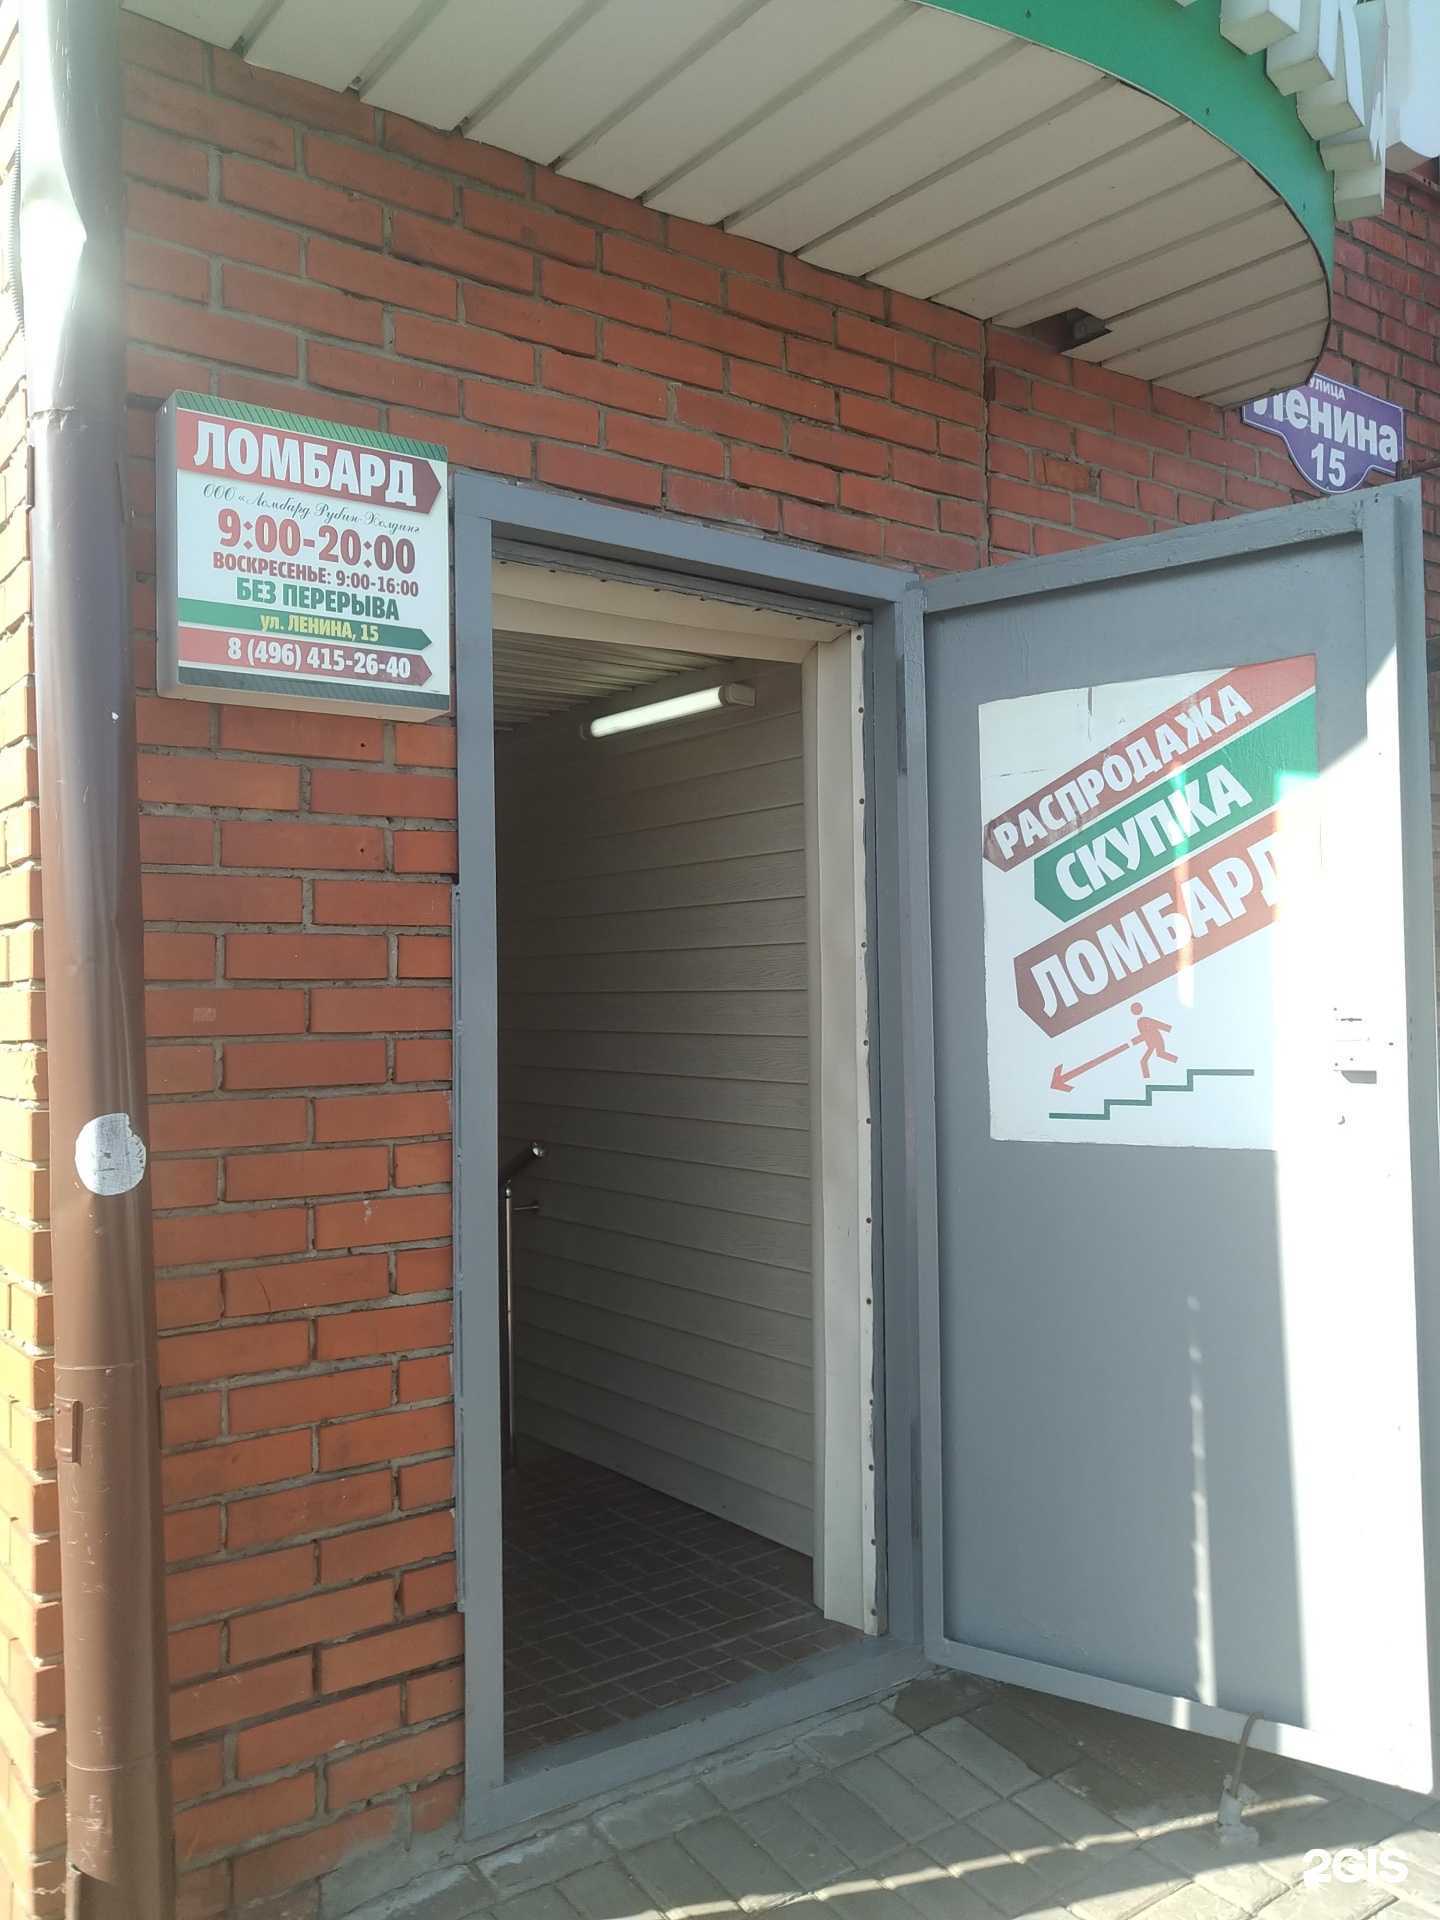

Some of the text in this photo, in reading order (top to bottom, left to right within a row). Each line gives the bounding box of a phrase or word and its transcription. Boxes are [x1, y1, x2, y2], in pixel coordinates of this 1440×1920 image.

[193, 420, 417, 507] ЛОМБАРД
[1311, 443, 1346, 487] 15
[203, 483, 237, 499] ООО
[218, 508, 415, 574] 9:00-20:00
[213, 551, 419, 598] ВОСКРЕСЕНЬЕ: 9:00-16:00
[236, 576, 400, 621] БЕЗ ПЕРЕРЫВА
[260, 614, 380, 642] ул. ЛЕНИНА, 15
[227, 637, 411, 679] 8 (496) 415-26-40
[993, 685, 1253, 859] РАСПРОДАЖА
[1055, 764, 1253, 900] СКУПКА
